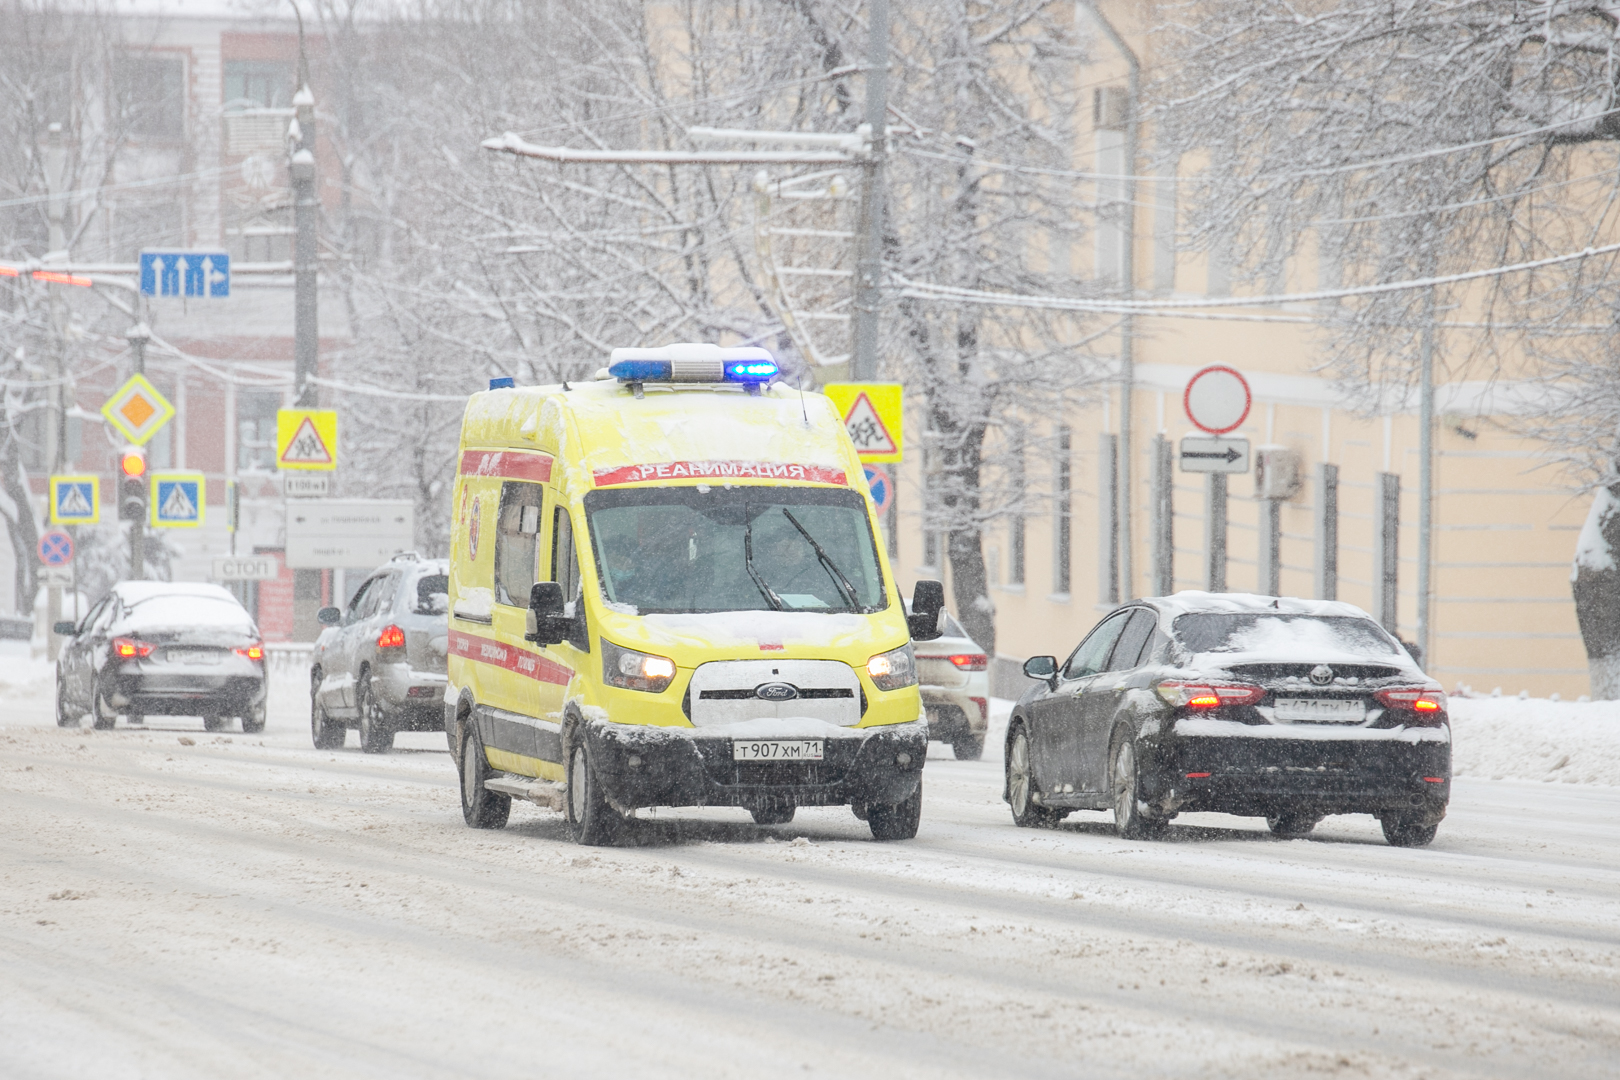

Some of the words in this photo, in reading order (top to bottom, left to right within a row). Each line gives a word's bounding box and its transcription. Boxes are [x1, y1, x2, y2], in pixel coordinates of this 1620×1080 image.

[640, 463, 805, 479] РЕАНИМАЦИЯ
[766, 687, 788, 697] Ford
[804, 742, 818, 753] 71
